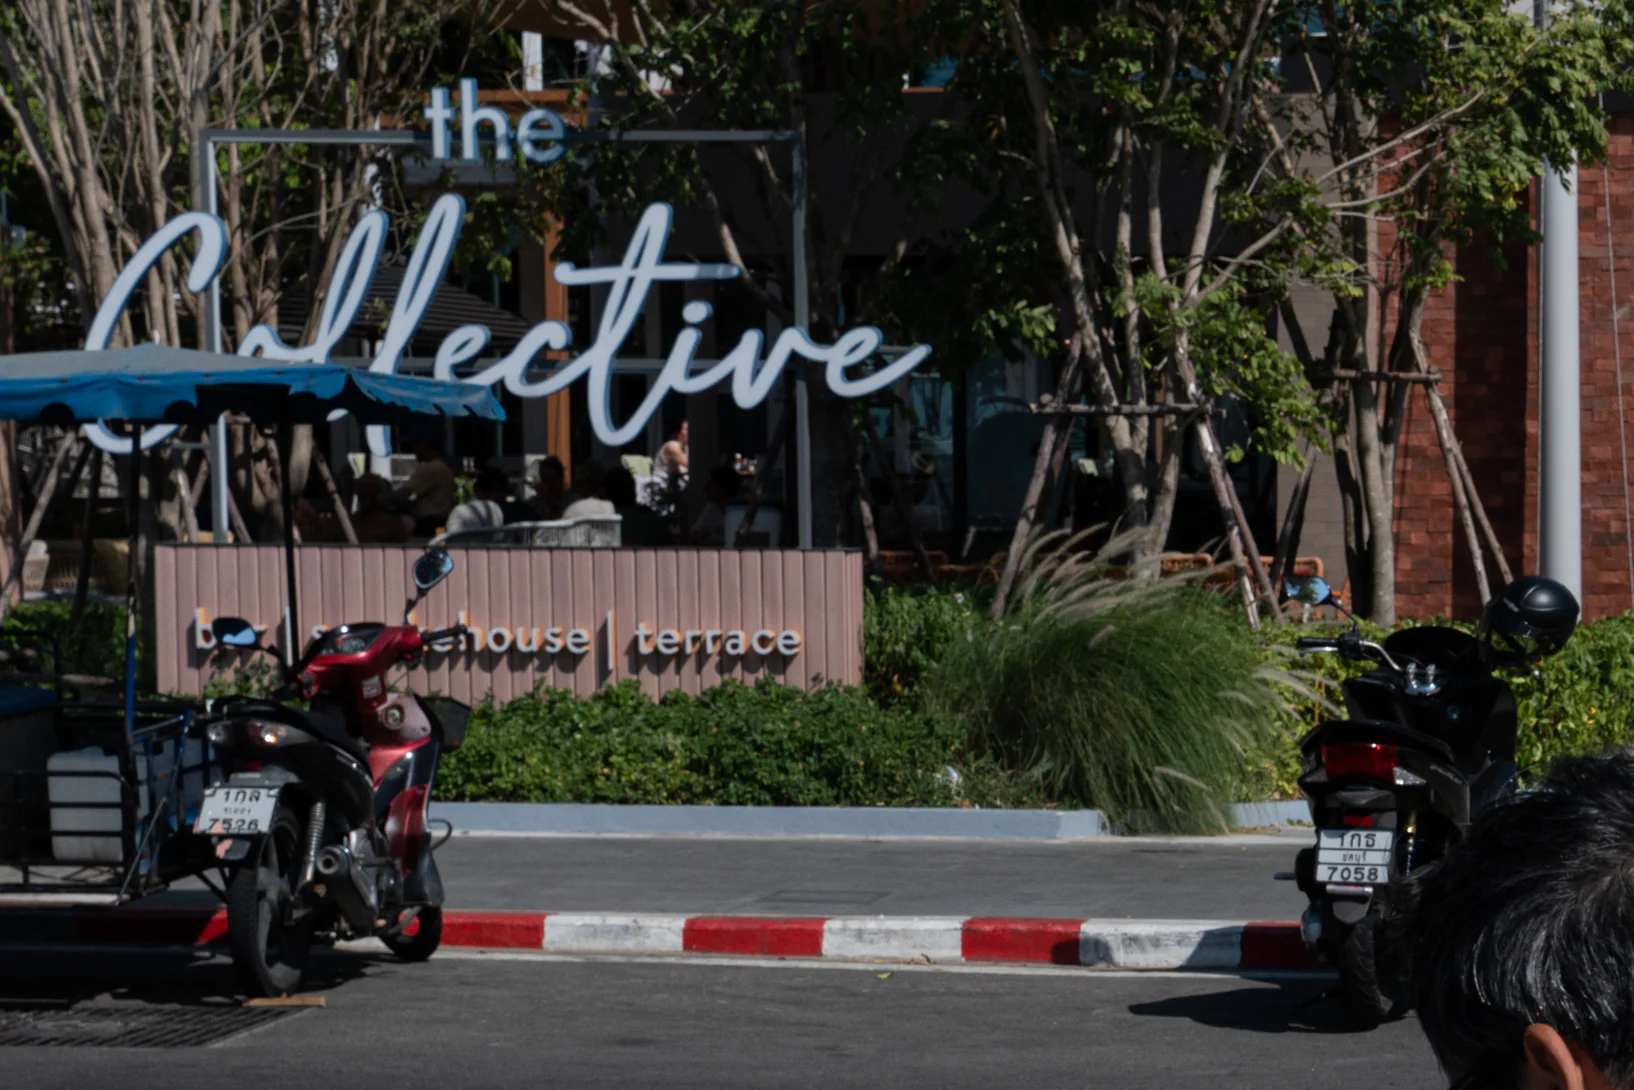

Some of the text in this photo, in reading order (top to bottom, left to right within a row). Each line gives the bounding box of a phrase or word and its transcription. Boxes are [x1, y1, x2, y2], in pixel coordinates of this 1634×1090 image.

[423, 77, 568, 164] the
[635, 621, 801, 656] terrace
[1327, 866, 1379, 882] 7058
